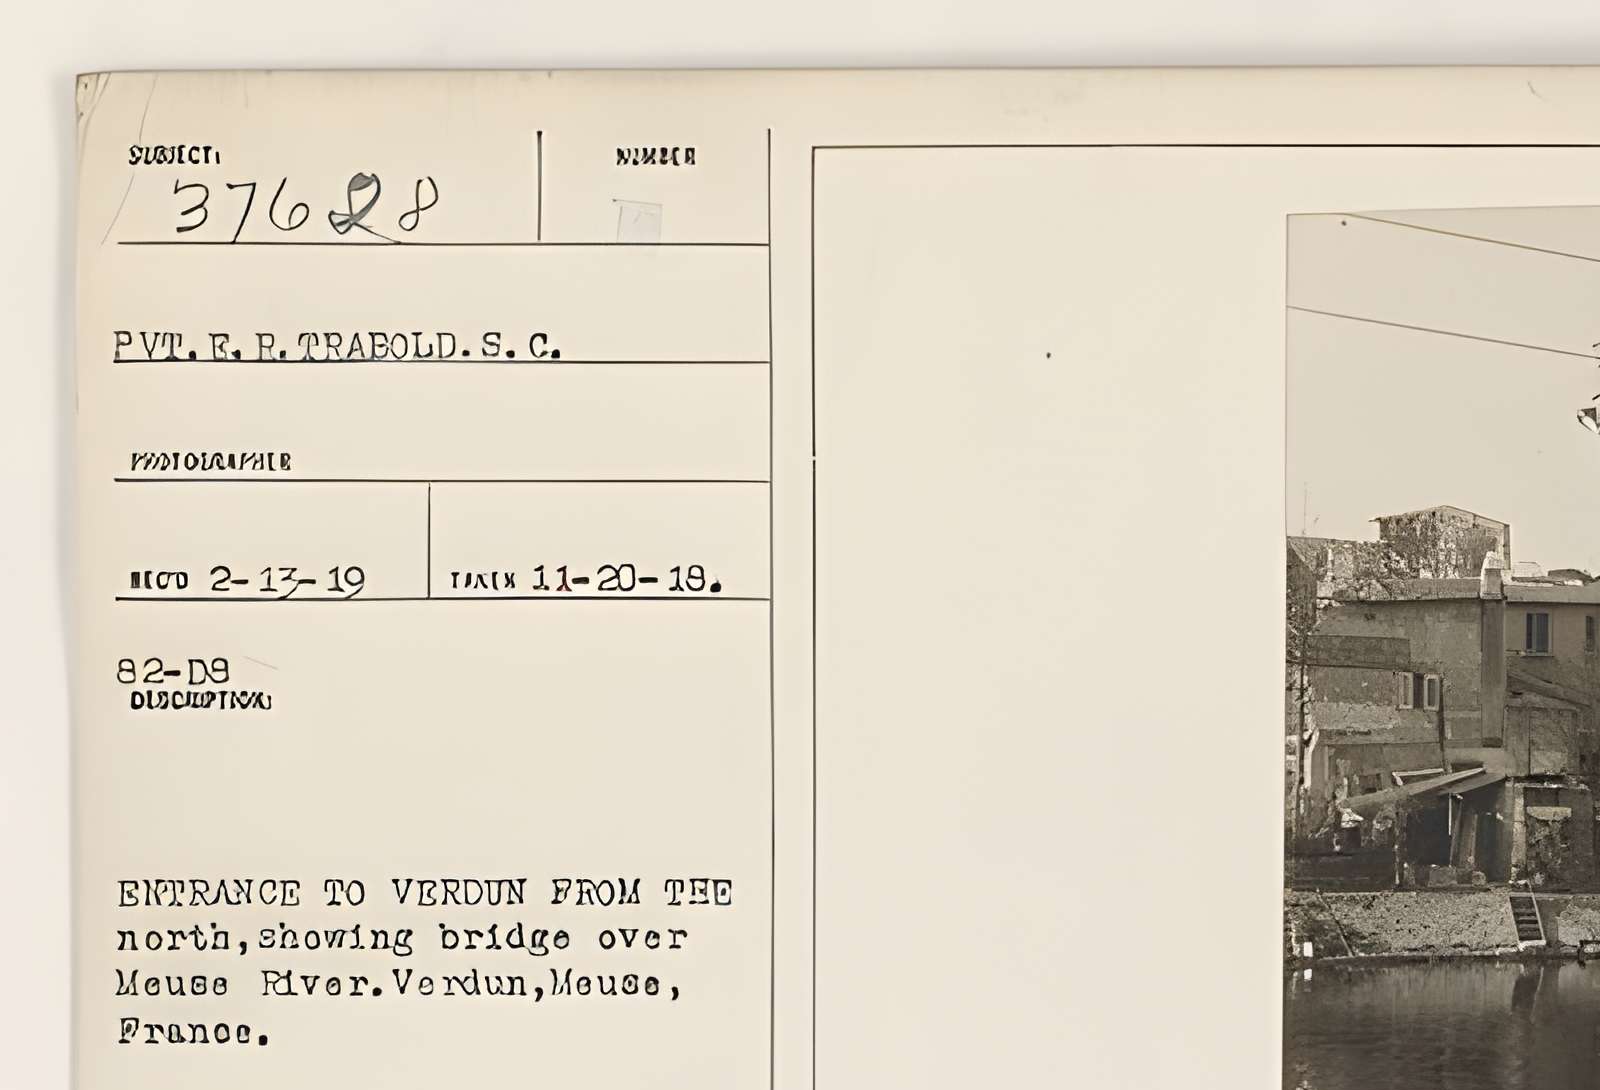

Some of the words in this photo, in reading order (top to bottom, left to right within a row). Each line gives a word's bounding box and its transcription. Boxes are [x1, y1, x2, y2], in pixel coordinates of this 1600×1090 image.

[173, 172, 439, 242] 37628
[210, 565, 365, 598] 2-13-19
[117, 878, 301, 908] ENTRANCE
[324, 878, 365, 907] TO
[391, 878, 528, 907] VERDUN
[550, 878, 641, 907] FROM
[664, 877, 732, 907] THE
[438, 922, 570, 958] bridge
[598, 928, 688, 951] over
[115, 968, 228, 997] Meuse
